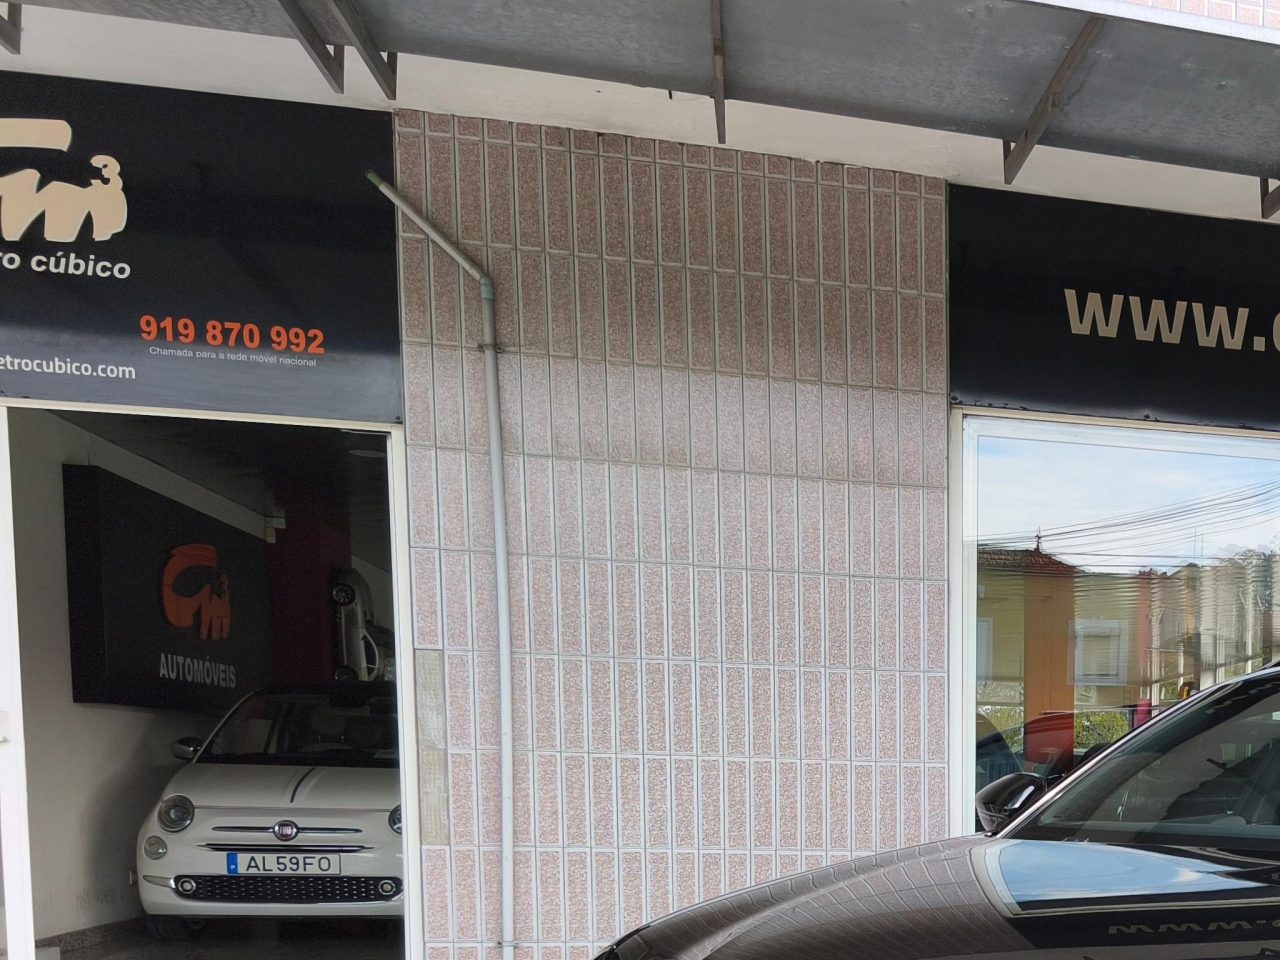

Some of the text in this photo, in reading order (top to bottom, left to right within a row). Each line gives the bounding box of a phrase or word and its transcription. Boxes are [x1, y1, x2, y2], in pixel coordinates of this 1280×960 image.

[31, 251, 131, 279] cúbico
[139, 315, 325, 354] 919 870 992
[149, 346, 194, 357] Chamada
[196, 351, 216, 360] para
[227, 353, 248, 362] rede
[250, 354, 277, 364] móvel
[279, 357, 317, 367] nacional
[159, 652, 236, 689] AUTOMÓVEIS
[245, 855, 331, 872] AL59FO
